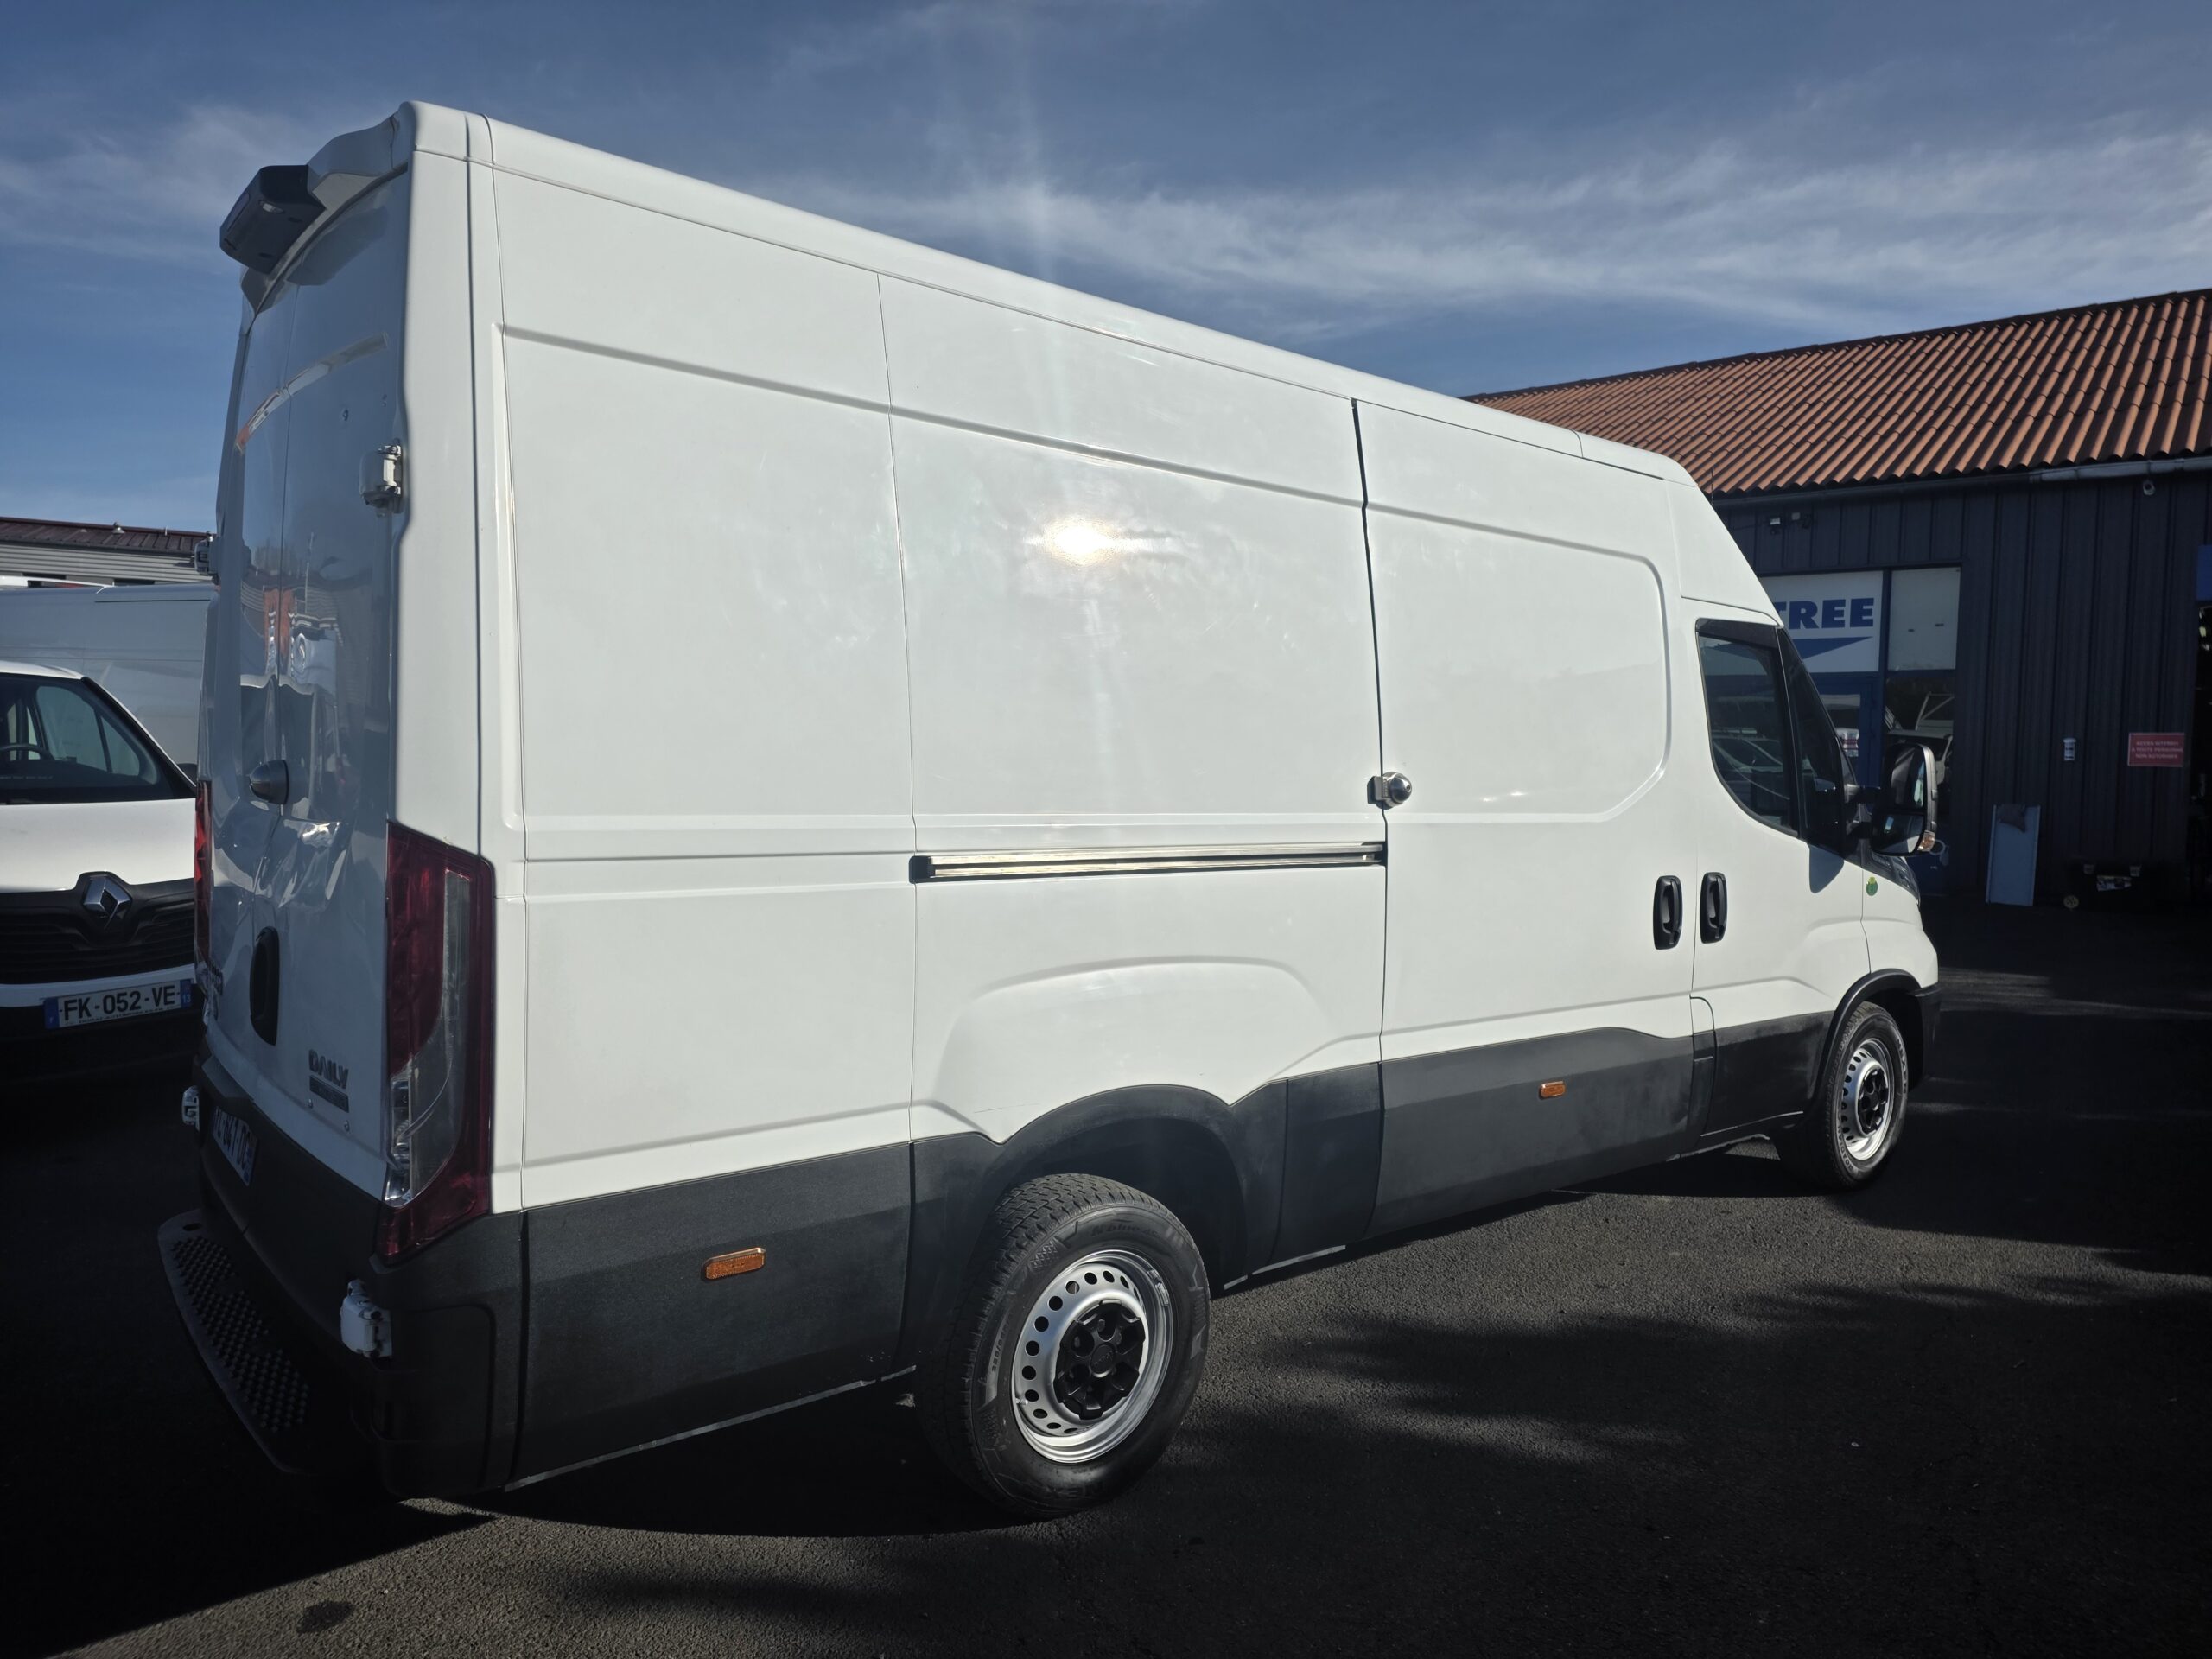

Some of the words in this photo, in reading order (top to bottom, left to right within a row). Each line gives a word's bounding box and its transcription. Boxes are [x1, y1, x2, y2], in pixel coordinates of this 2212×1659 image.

[64, 985, 175, 1020] FK-052-VE
[182, 993, 191, 1004] 13
[308, 1049, 349, 1090] DAILY
